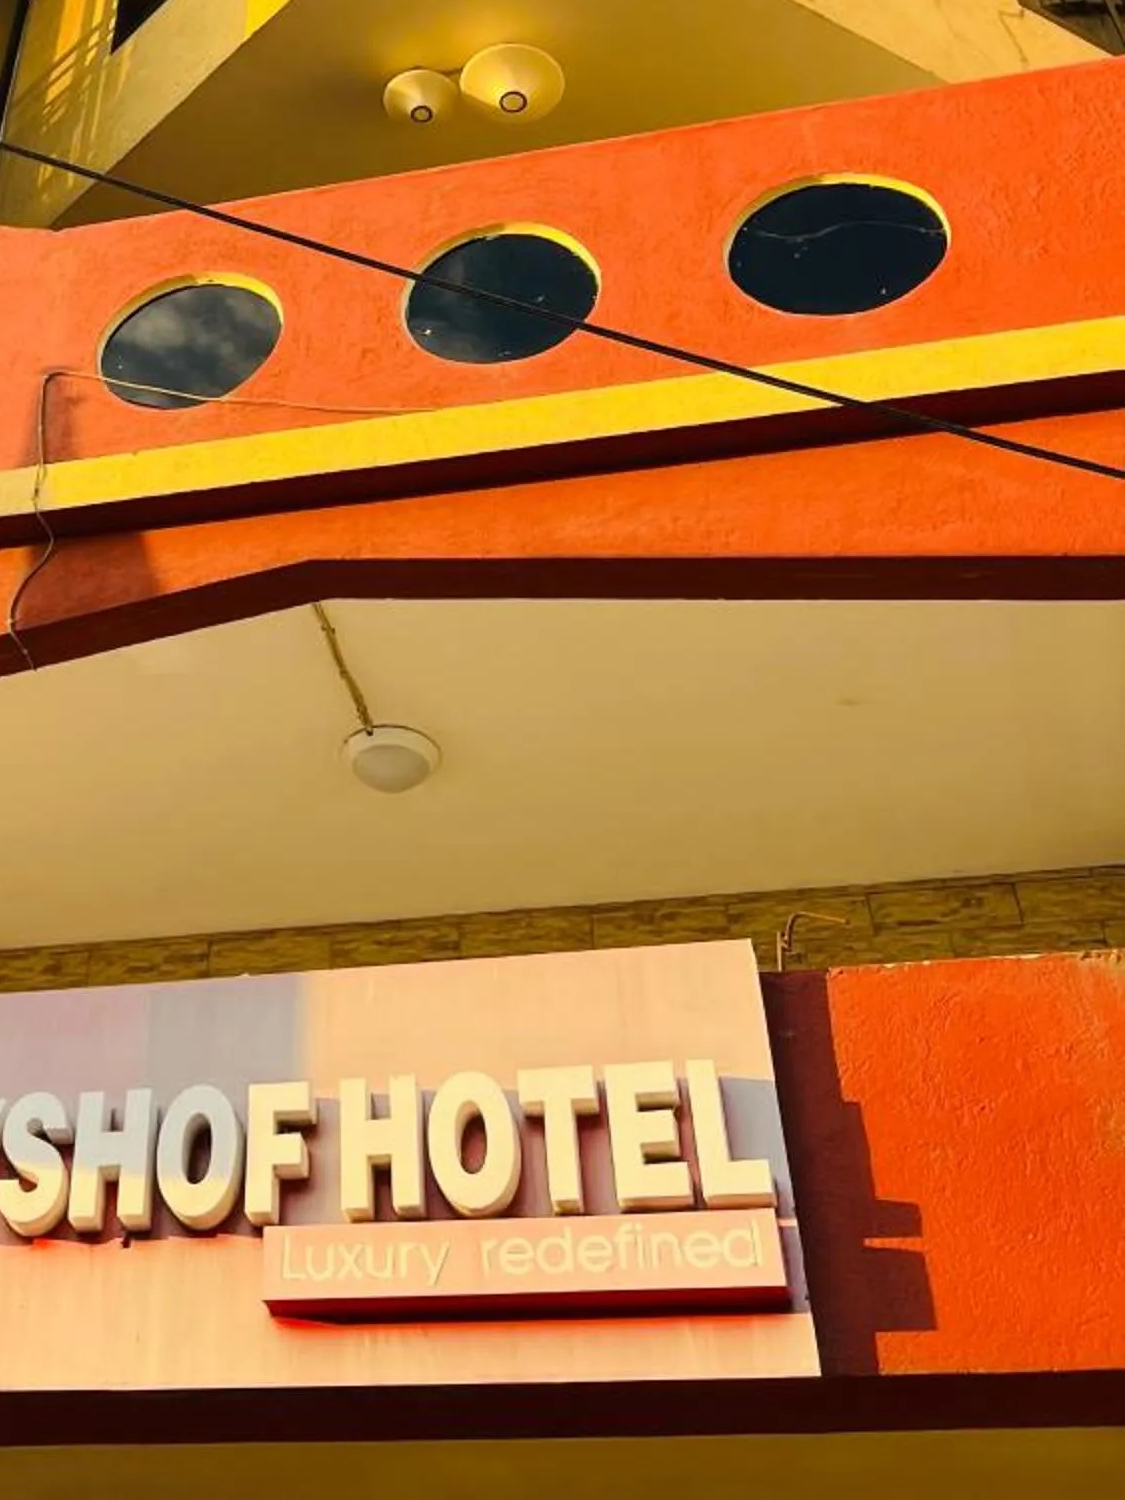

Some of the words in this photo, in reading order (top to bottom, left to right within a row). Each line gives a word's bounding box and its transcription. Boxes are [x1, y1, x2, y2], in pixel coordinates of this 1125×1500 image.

[339, 1059, 776, 1223] HOTEL
[281, 1234, 451, 1286] Luxury
[481, 1219, 764, 1275] redefined
